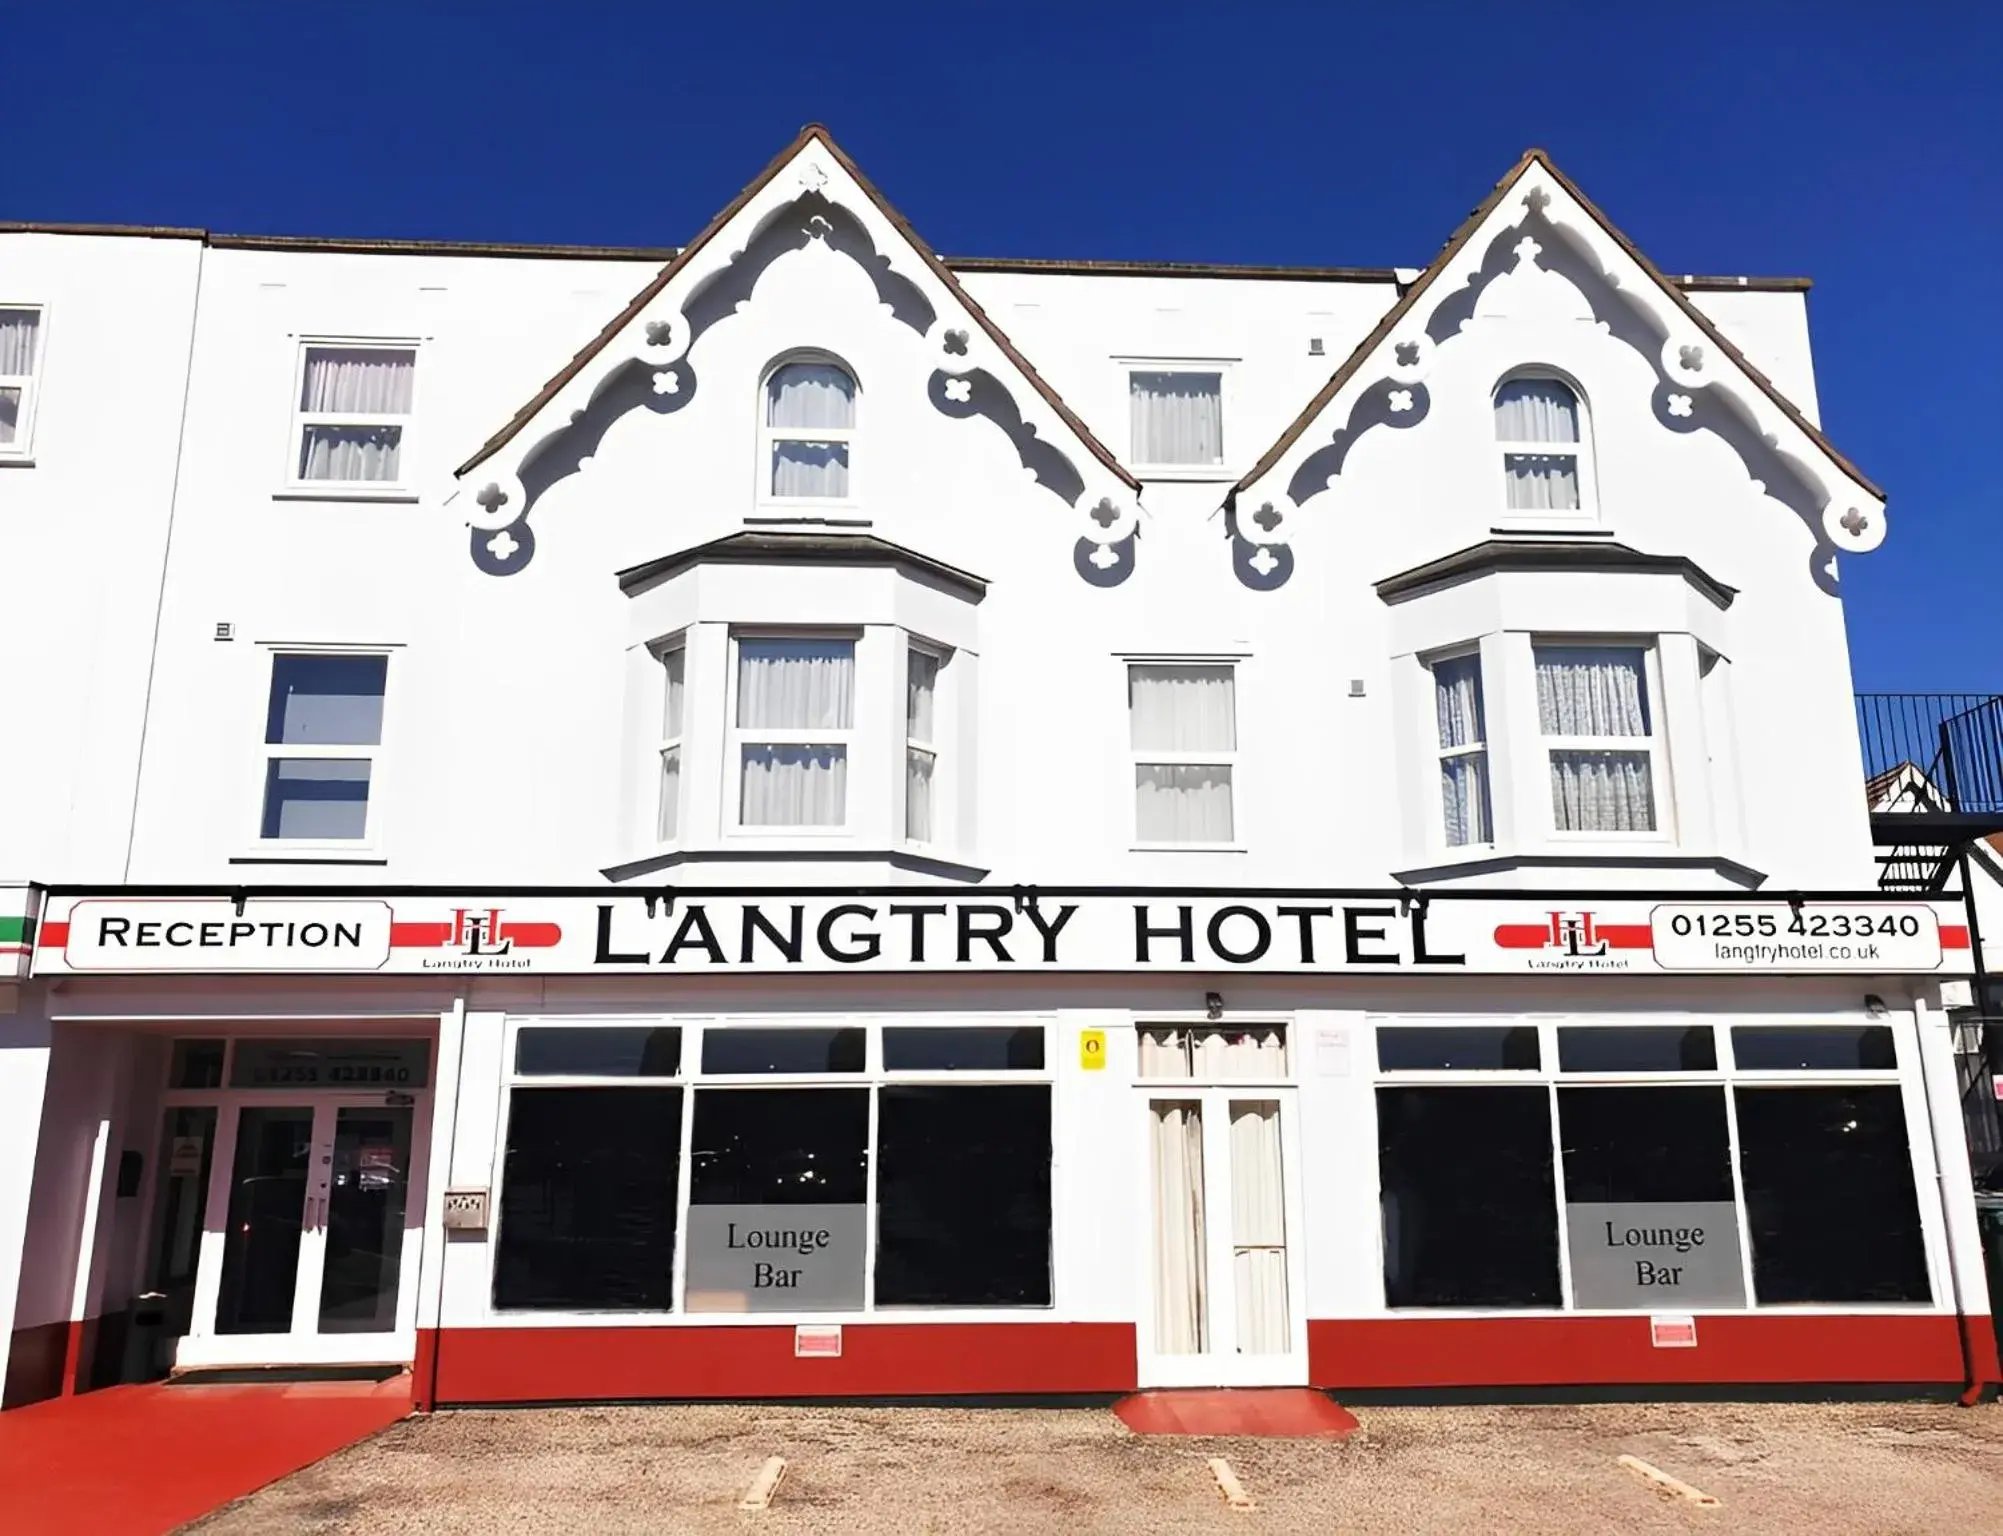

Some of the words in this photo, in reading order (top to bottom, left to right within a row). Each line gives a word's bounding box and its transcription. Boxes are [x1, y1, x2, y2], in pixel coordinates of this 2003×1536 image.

[98, 917, 361, 948] RECEPTION
[594, 903, 1079, 965] LANGTRY
[1133, 904, 1465, 965] HOTEL
[1671, 914, 1777, 937] 01255
[1787, 914, 1919, 937] 423340
[1715, 943, 1880, 964] langtryhotel.co.uk
[727, 1223, 830, 1255] Lounge
[1606, 1221, 1705, 1253] Lounge
[753, 1262, 803, 1288] Bar
[1635, 1260, 1683, 1286] Bar
